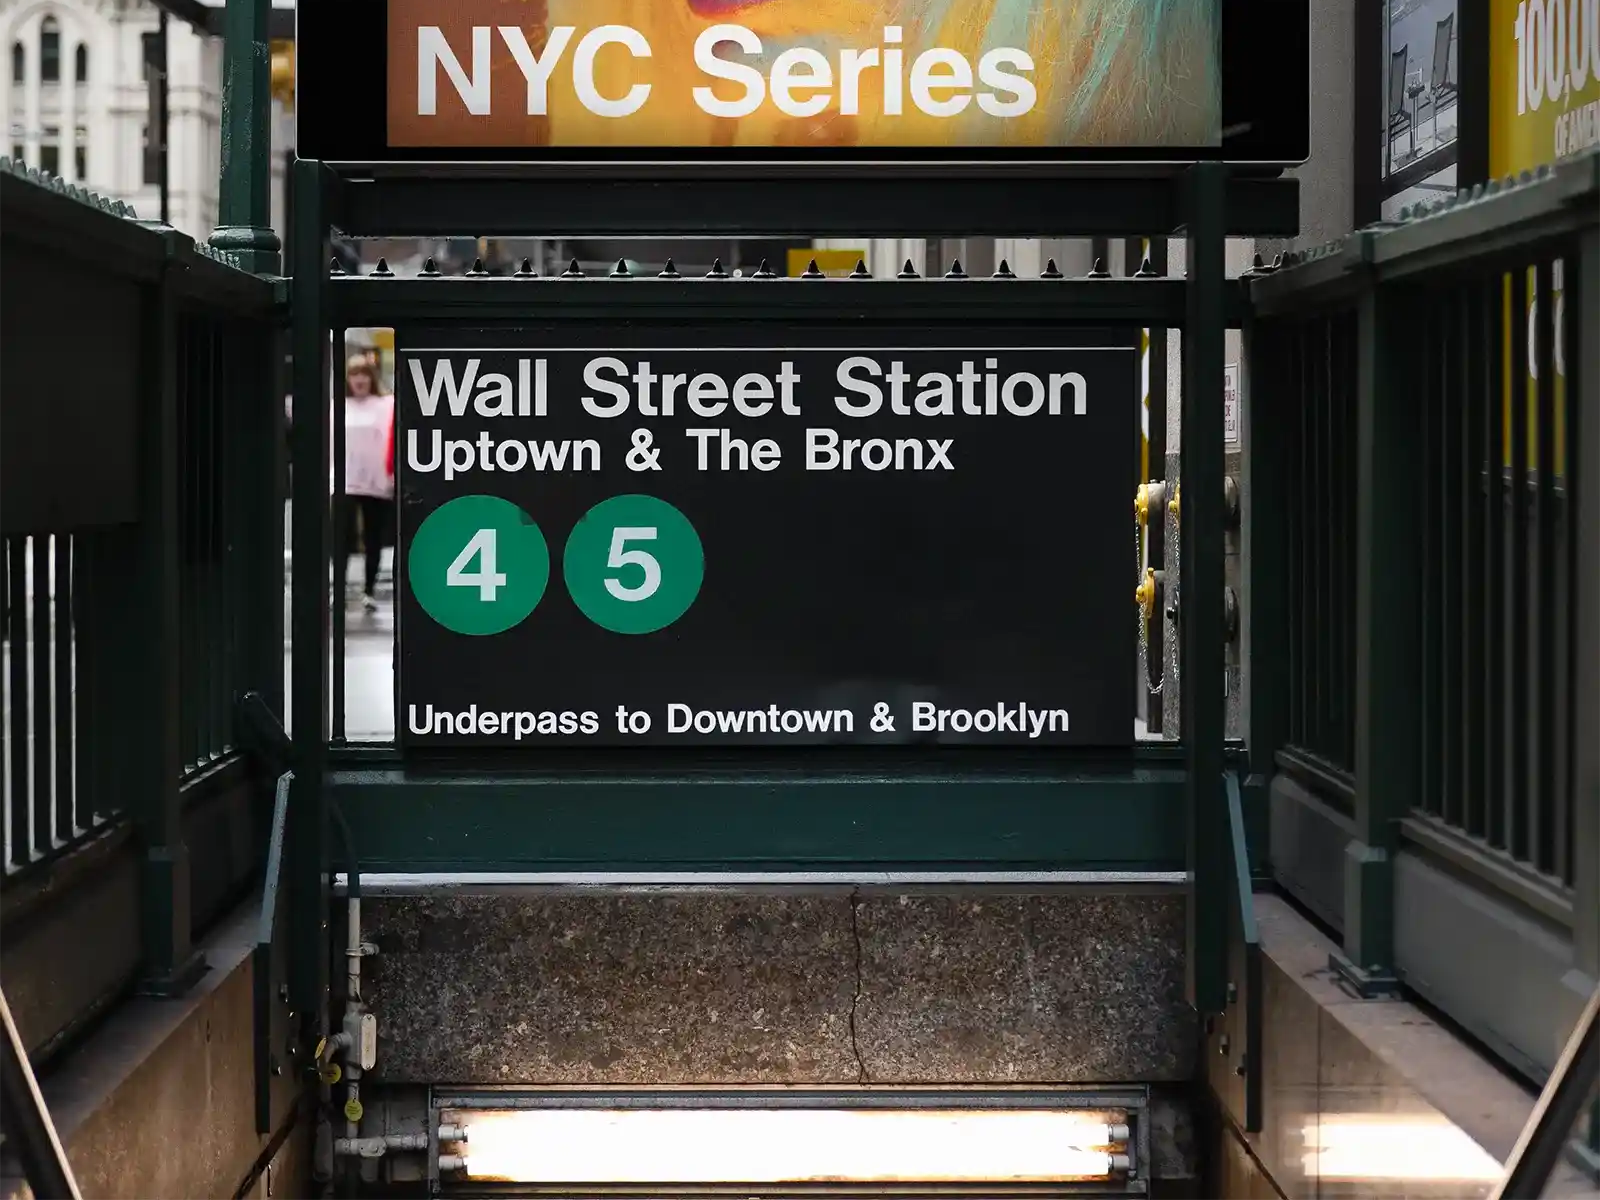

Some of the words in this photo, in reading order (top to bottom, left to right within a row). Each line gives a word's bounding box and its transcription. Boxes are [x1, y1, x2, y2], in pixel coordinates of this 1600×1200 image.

[418, 24, 653, 118] NYC
[692, 23, 1037, 118] Series
[408, 358, 547, 417] Wall
[581, 357, 800, 418] Street
[835, 357, 1087, 418] Station
[407, 429, 600, 480] Uptown
[626, 428, 662, 471] &
[686, 429, 782, 471] The
[806, 429, 955, 471] Bronx
[447, 528, 507, 601] 4
[604, 527, 661, 602] 5
[408, 705, 598, 740] Underpass
[616, 705, 651, 734] to
[668, 703, 853, 734] Downtown
[870, 702, 896, 733] &
[913, 702, 1069, 739] Brooklyn
